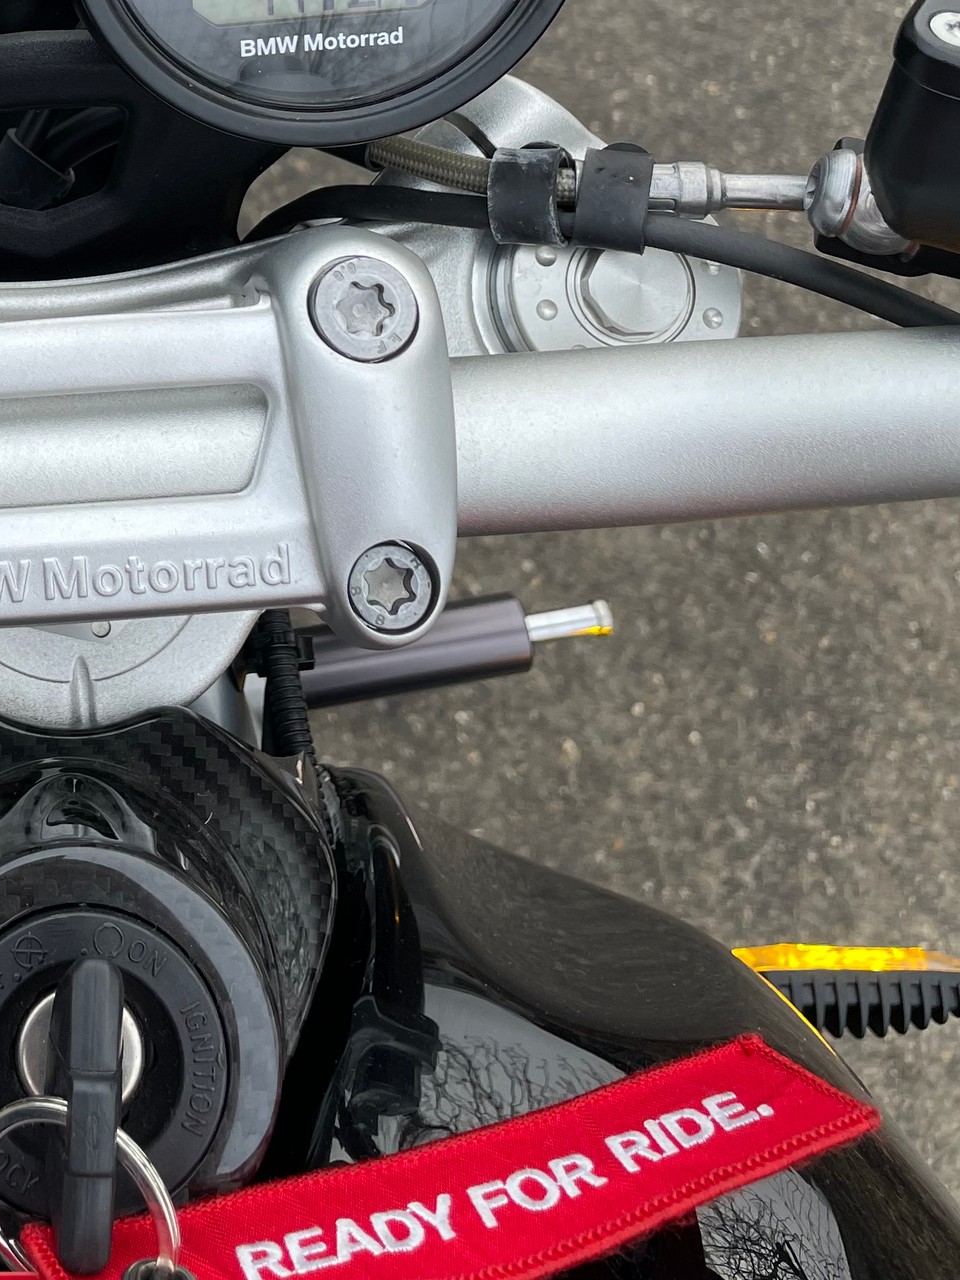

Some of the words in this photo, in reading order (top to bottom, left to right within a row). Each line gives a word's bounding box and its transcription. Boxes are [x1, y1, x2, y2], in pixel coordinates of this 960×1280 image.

[240, 35, 299, 57] BMW
[303, 26, 403, 51] Motorrad
[42, 542, 291, 601] Motorrad
[133, 938, 167, 978] ON
[180, 1000, 225, 1138] IGNITION
[236, 1192, 456, 1280] READY
[468, 1153, 608, 1228] FOR
[605, 1090, 775, 1173] RIDE.
